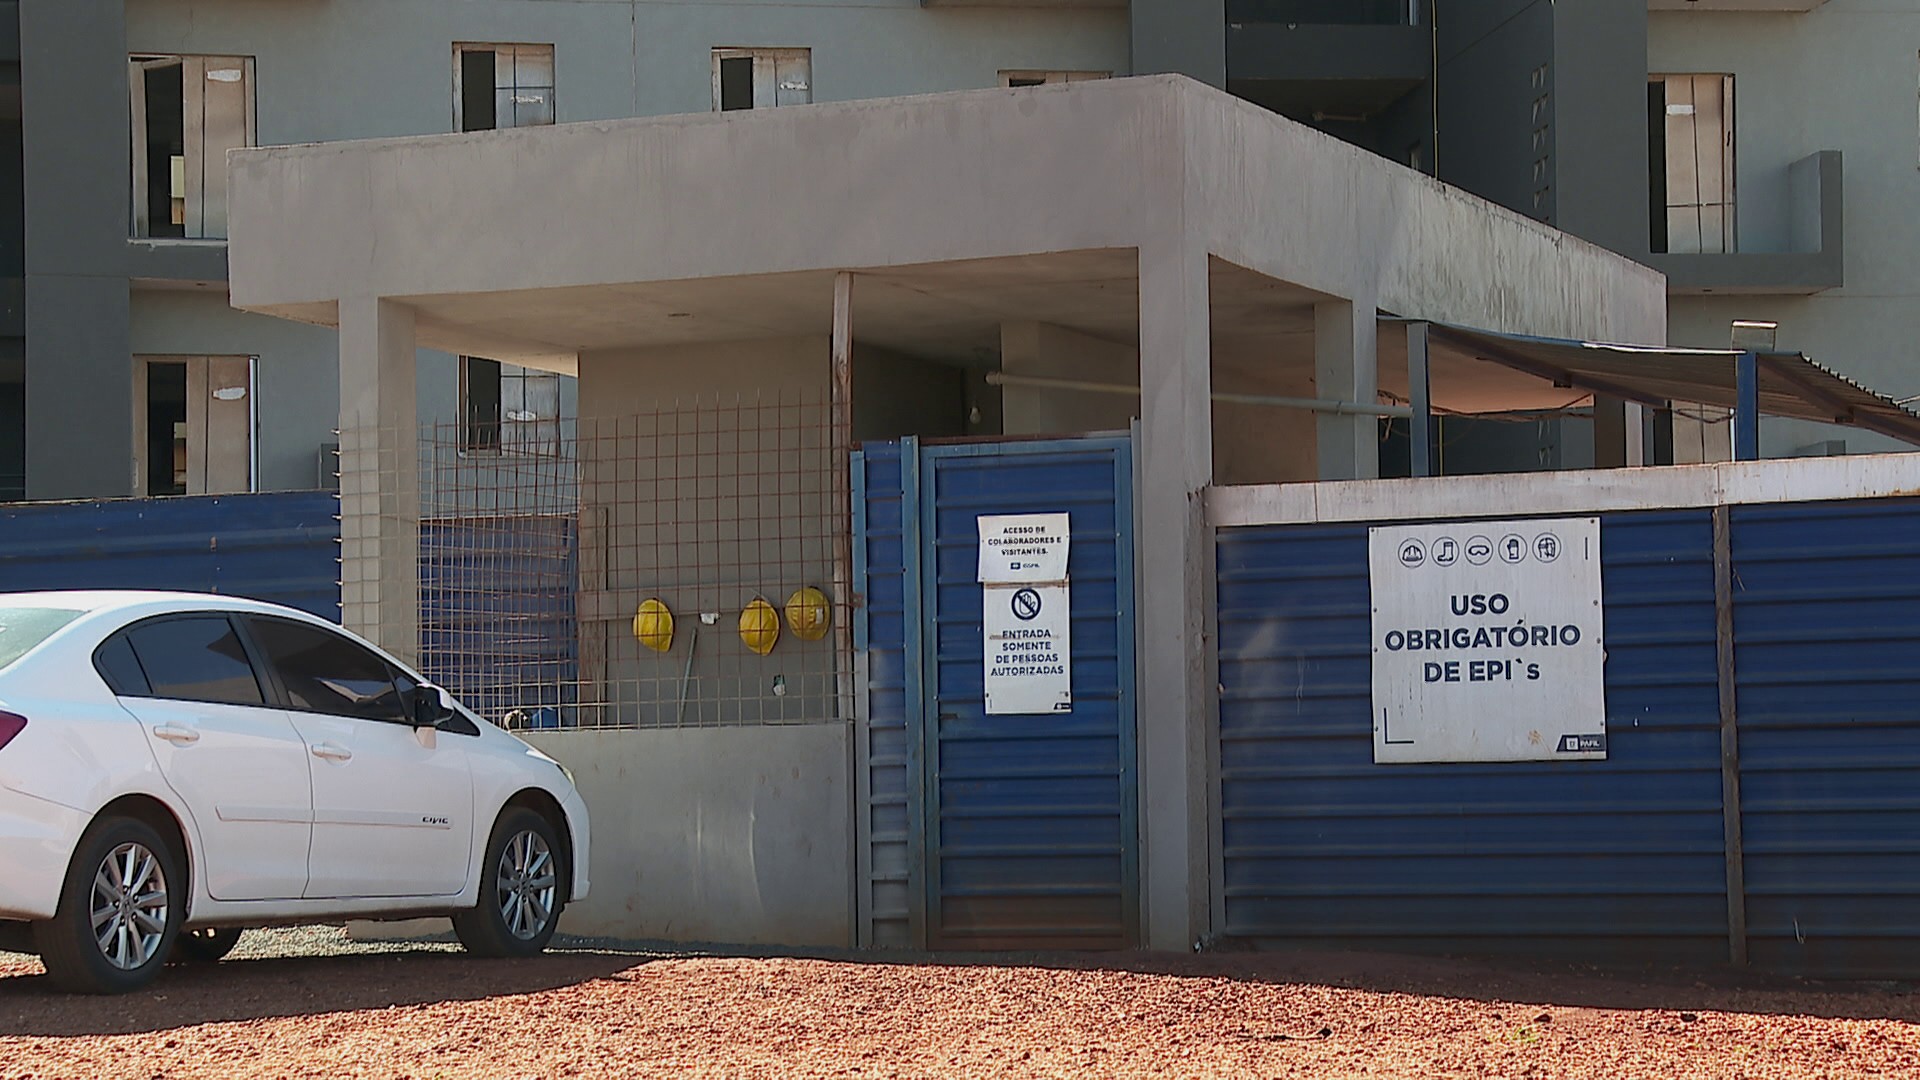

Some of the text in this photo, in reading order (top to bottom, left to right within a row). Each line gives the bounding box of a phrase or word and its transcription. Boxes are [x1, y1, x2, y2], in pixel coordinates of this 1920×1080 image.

[1003, 526, 1034, 534] ACESSO
[1450, 593, 1510, 616] USO
[1002, 629, 1051, 639] ENTRADA
[1384, 618, 1581, 651] OBRIGATÓRIO
[1002, 641, 1052, 651] SOMENTE
[995, 653, 1059, 664] DE PESSOAS
[990, 665, 1064, 676] AUTORIZADAS
[1424, 661, 1461, 682] DE
